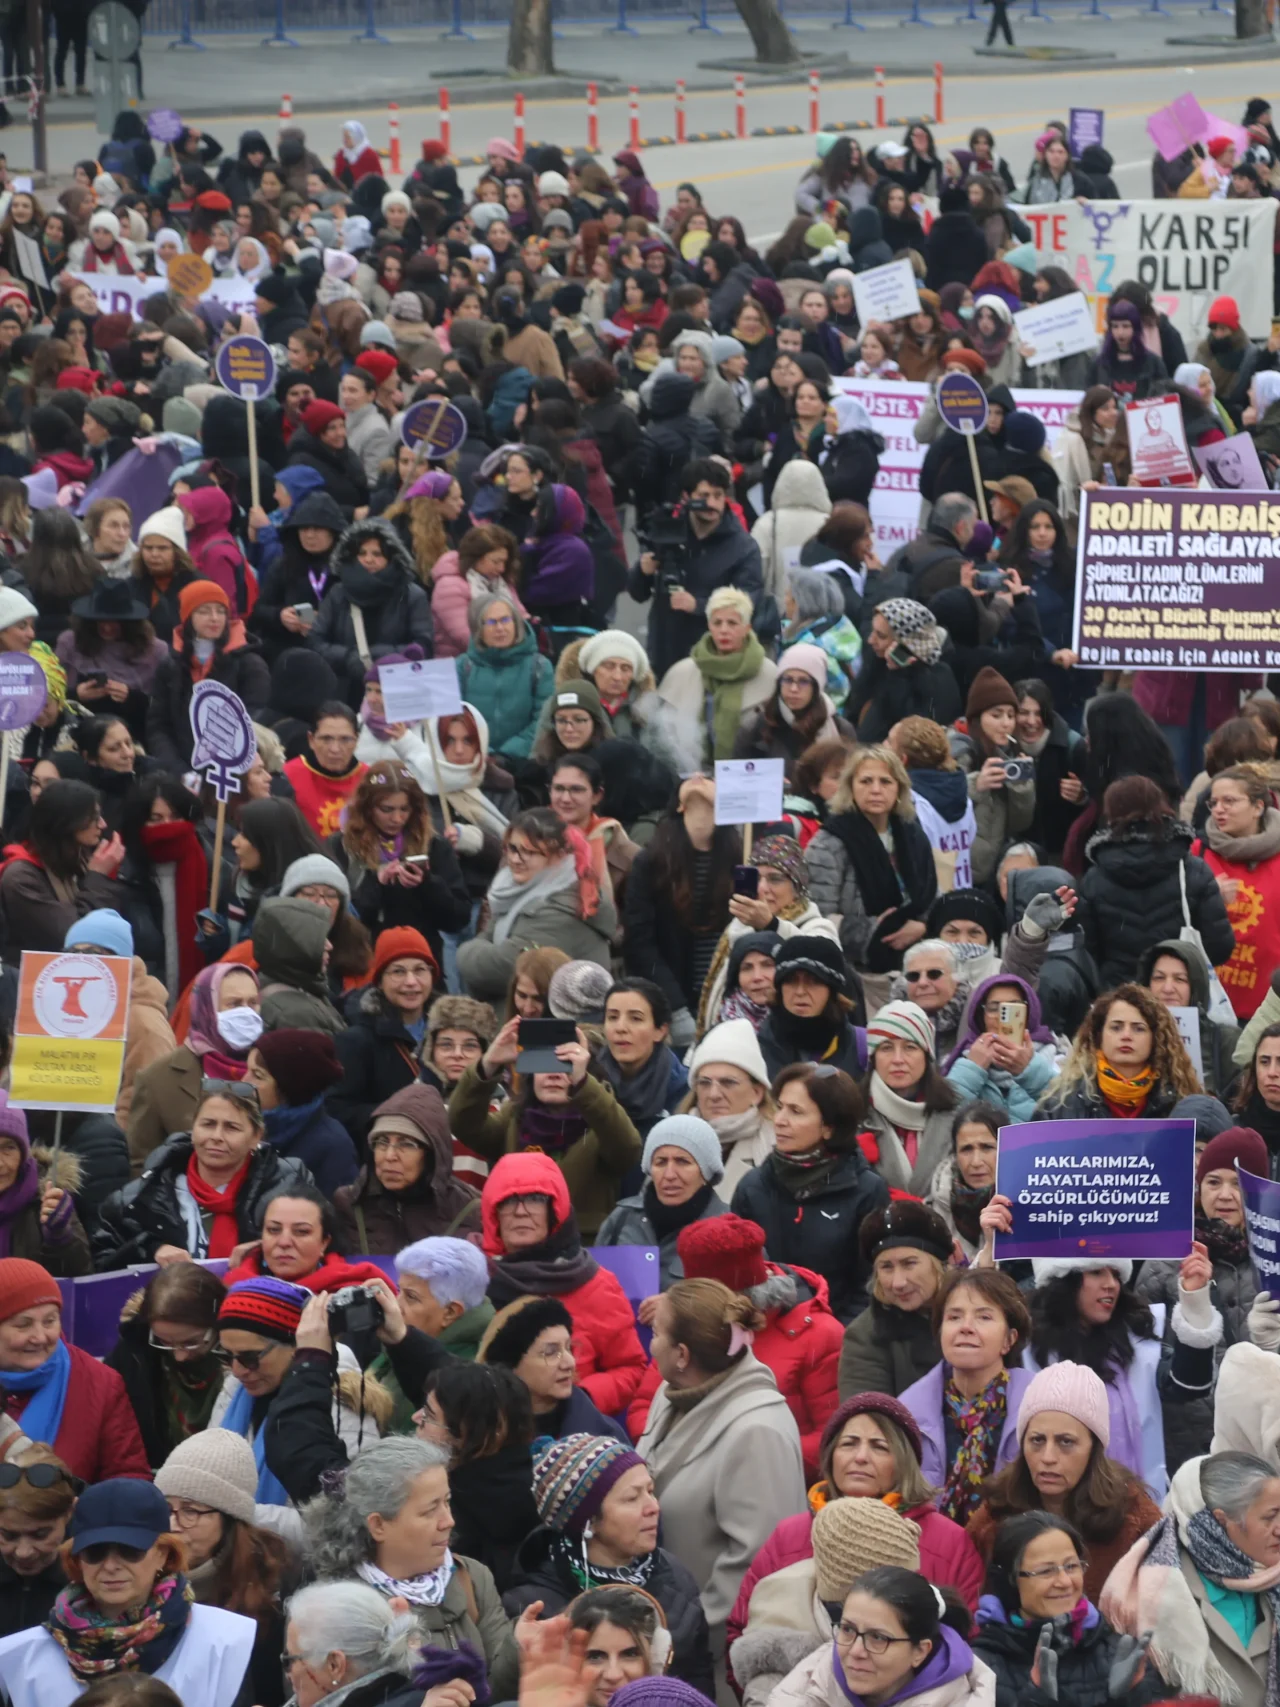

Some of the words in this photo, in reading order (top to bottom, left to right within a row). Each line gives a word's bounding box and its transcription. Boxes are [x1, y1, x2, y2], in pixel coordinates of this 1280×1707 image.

[1026, 213, 1068, 251] TE
[1138, 212, 1249, 253] KARŞI
[1136, 253, 1230, 292] OLUP
[1089, 498, 1173, 532] ROJİN
[1087, 531, 1174, 558] ADALETİ
[1085, 562, 1142, 585] ŞÜPHELİ
[1143, 564, 1183, 584] KADIN
[1184, 562, 1264, 585] ÖLÜMLERİNİ
[1085, 582, 1204, 605] AYDINLATACAĞIZ!
[1083, 606, 1104, 622] 30
[1163, 607, 1206, 627] Büyük
[1082, 626, 1100, 638] ve
[1103, 624, 1151, 640] Adalet
[1154, 625, 1221, 642] Bakanlığı
[1081, 646, 1120, 663] Rojin
[1125, 647, 1174, 666] Kabaiş
[1212, 649, 1260, 665] Adalet
[939, 829, 970, 853] KAD
[40, 1050, 80, 1060] MALATYA
[33, 1061, 67, 1072] SULTAN
[70, 1062, 98, 1074] ABDAL
[1034, 1155, 1155, 1171] HAKLARIMIZA,
[1027, 1173, 1162, 1187] HAYATLARIMIZA
[1017, 1189, 1170, 1205] ÖZGÜRLÜĞÜMÜZE
[1028, 1209, 1074, 1225] sahip
[1078, 1209, 1159, 1226] çıkıyoruz!
